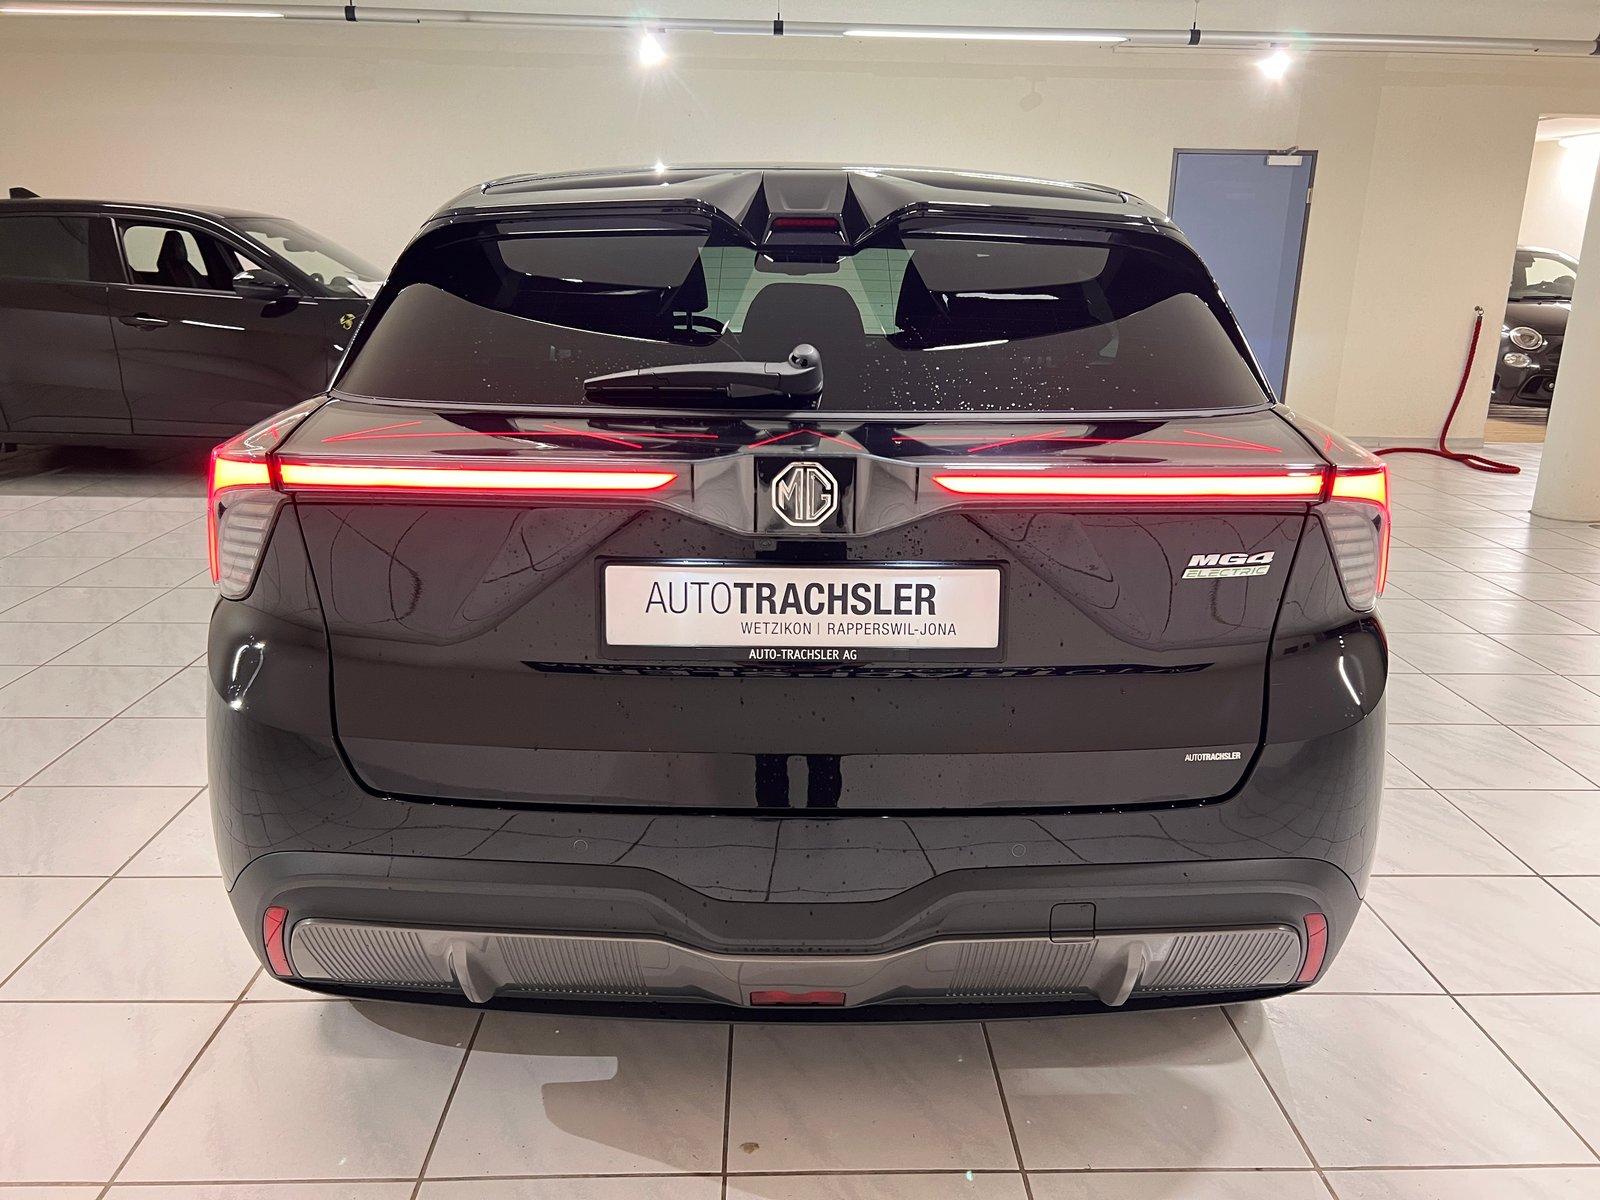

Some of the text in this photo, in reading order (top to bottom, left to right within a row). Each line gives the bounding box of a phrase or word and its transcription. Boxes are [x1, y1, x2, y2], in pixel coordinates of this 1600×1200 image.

[777, 466, 832, 521] MG
[1187, 551, 1275, 566] MG4
[1184, 566, 1269, 578] ELECTRIC
[645, 581, 937, 616] AUTOTRACHSLER
[740, 621, 957, 636] WETZIKON RAPPERSWIL-JONA
[749, 649, 857, 660] AUTO-TRACHSLER AG
[1184, 751, 1241, 762] AUTOTRACHSLER
